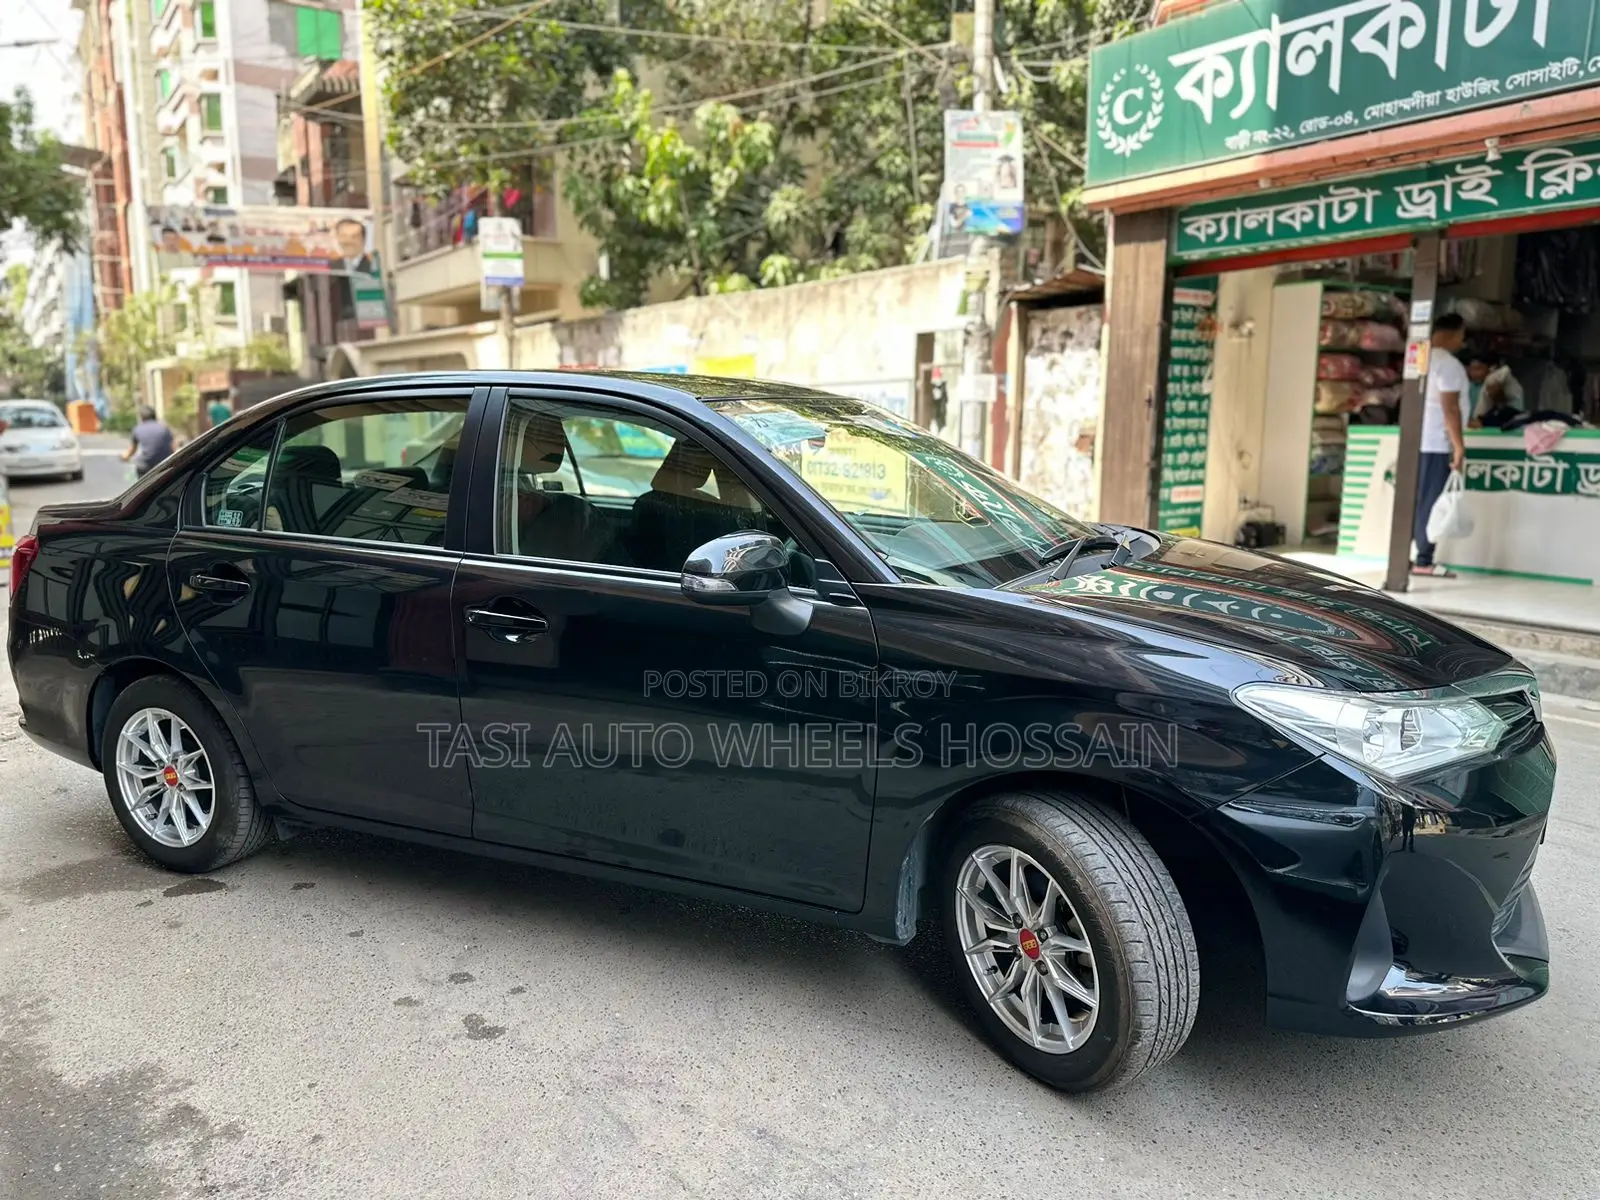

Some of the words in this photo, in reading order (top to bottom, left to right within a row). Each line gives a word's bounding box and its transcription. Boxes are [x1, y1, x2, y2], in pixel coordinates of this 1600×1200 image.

[1112, 87, 1144, 125] C
[1183, 187, 1382, 243] ক্যালকাটা
[1396, 164, 1504, 222] ড্রাই
[1515, 147, 1600, 201] ক্লি
